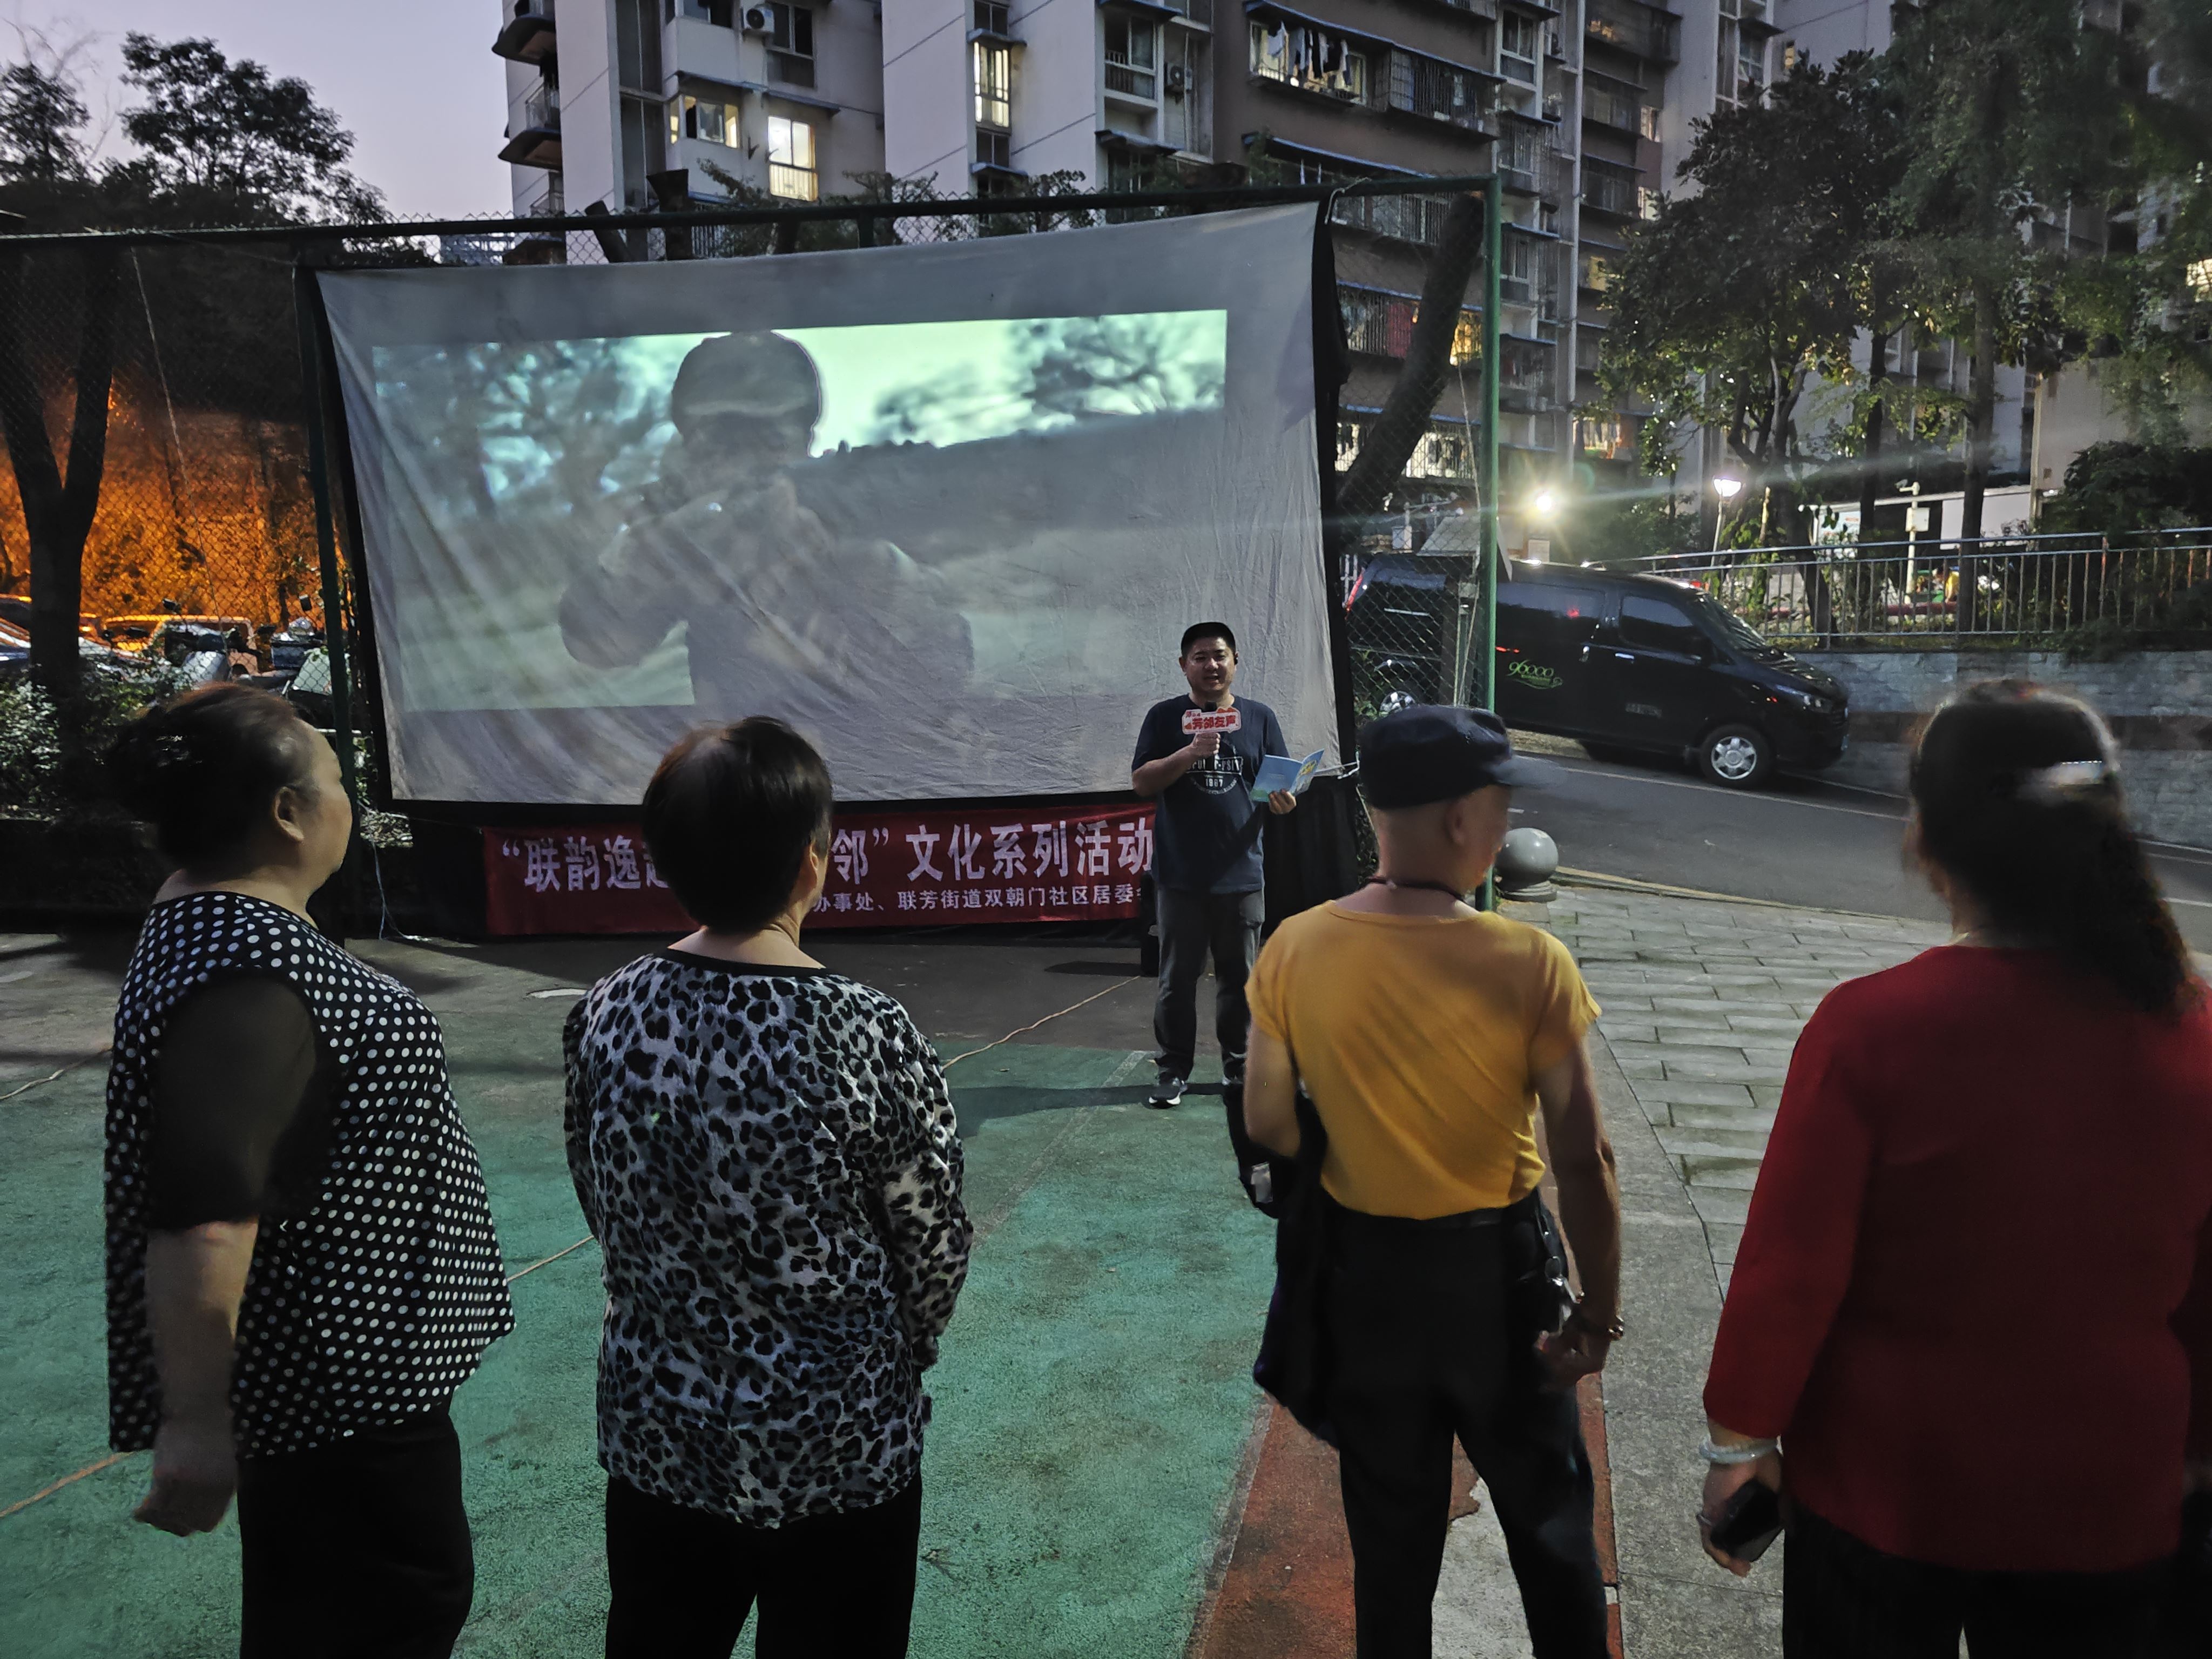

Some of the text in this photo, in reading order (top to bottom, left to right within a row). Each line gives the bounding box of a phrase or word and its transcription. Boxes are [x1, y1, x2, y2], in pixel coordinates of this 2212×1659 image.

[1505, 659, 1554, 677] 96000
[813, 883, 1141, 913] 办事处、联芳街道双朝门社区居委
